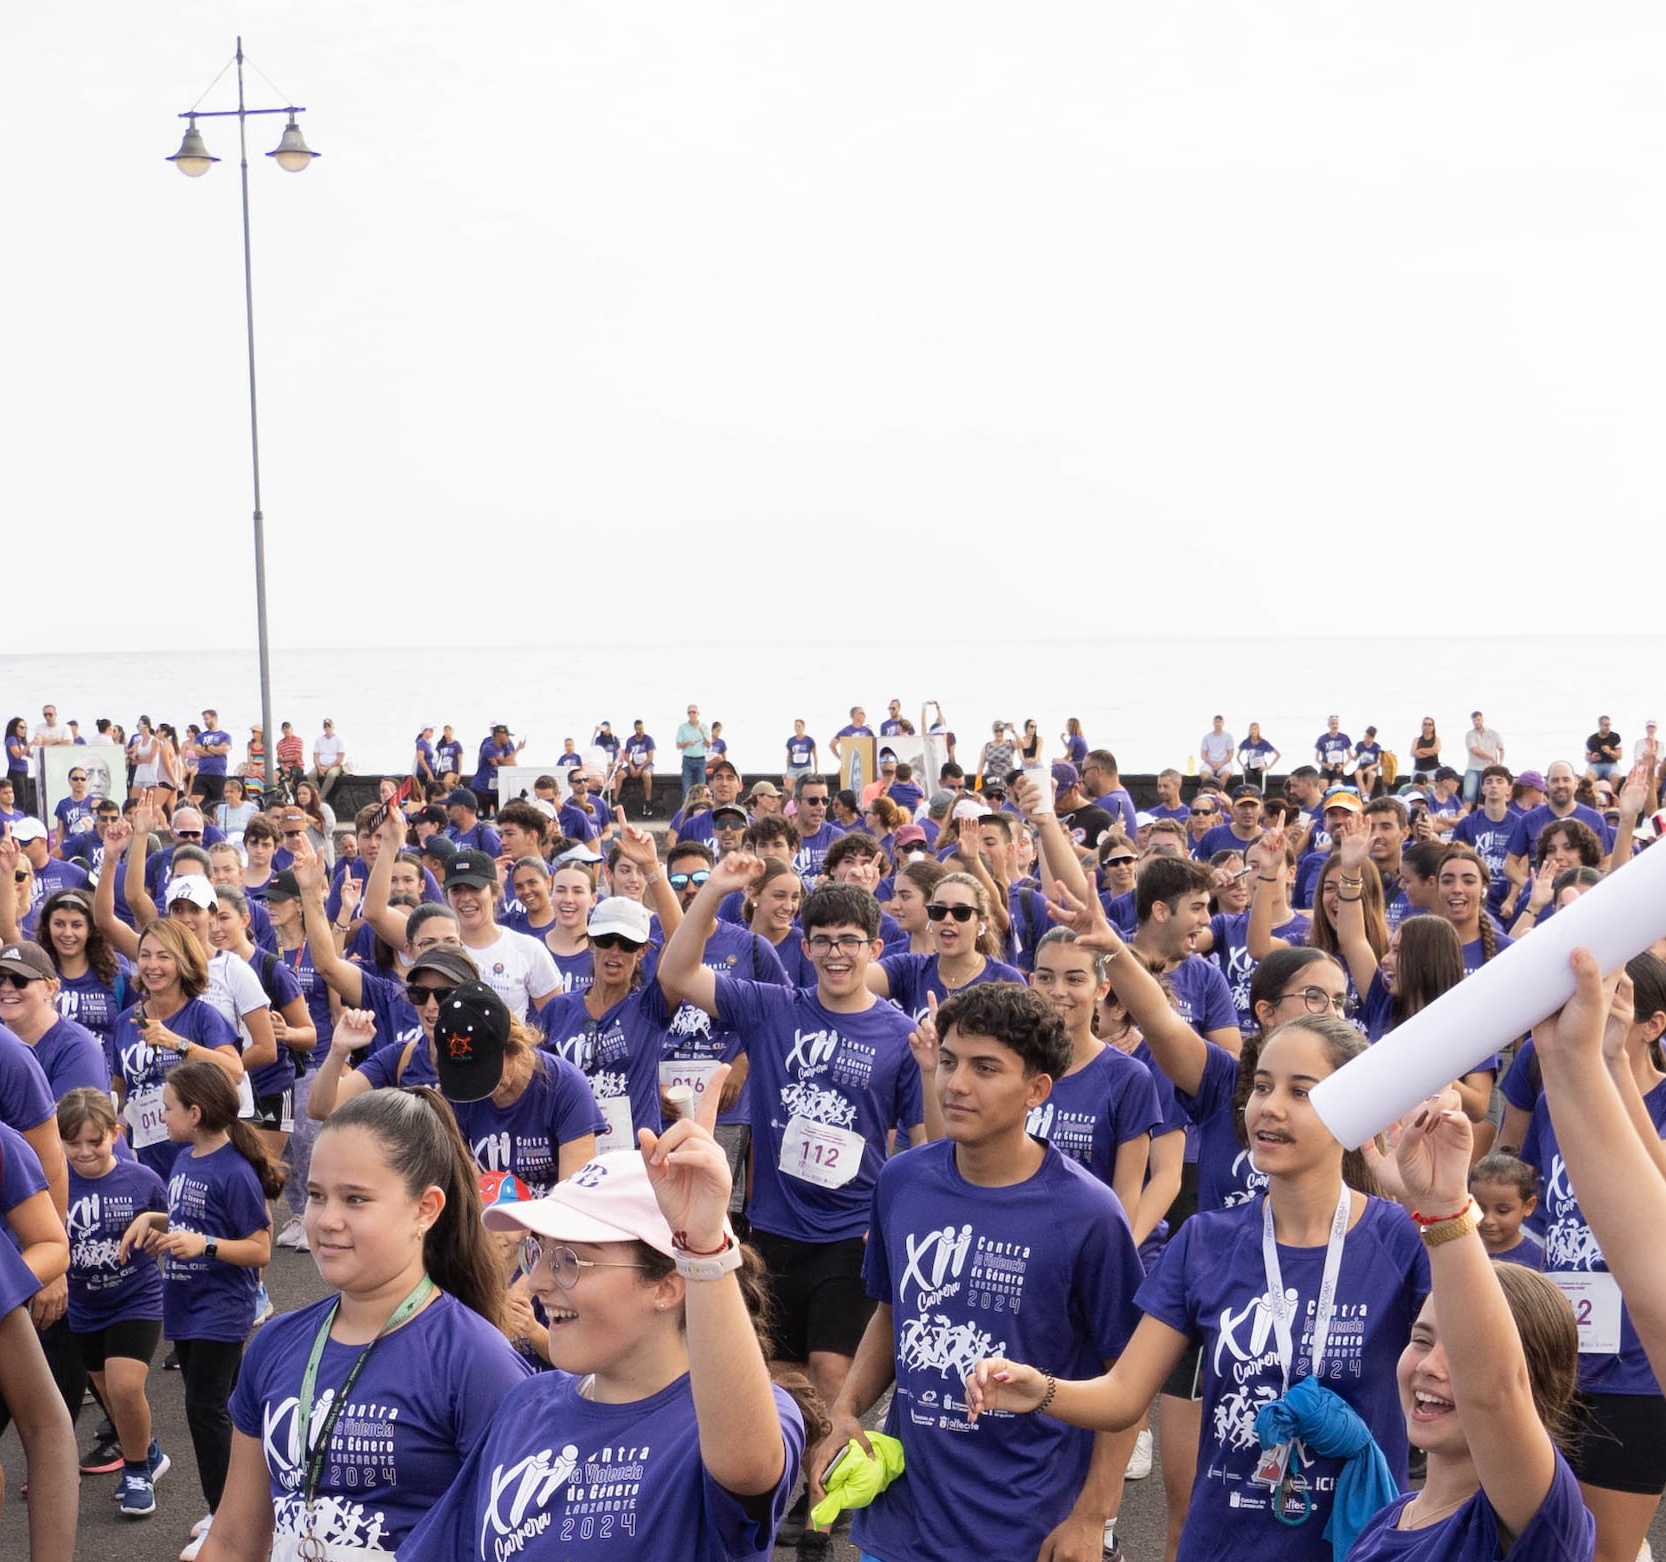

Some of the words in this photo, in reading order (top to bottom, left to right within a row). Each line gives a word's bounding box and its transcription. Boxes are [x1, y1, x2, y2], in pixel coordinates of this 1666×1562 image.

[841, 1037, 876, 1056] Contra
[847, 1056, 872, 1071] Género
[832, 1071, 870, 1090] 2024
[1057, 1109, 1096, 1124] Contra
[516, 1136, 549, 1147] Contra
[1064, 1131, 1093, 1143] Género
[801, 1140, 840, 1168] 112
[977, 1236, 1031, 1258] Contra
[971, 1266, 982, 1278] de
[986, 1268, 1023, 1285] Género
[970, 1279, 1022, 1296] LANZAROTE
[917, 1282, 961, 1313] Carrera
[967, 1290, 1020, 1315] 2024
[331, 1436, 343, 1450] de
[348, 1436, 394, 1452] Género
[331, 1453, 394, 1465] LANZAROTE
[330, 1466, 397, 1486] 2024
[585, 1462, 644, 1484] Violencia
[567, 1486, 584, 1501] de
[590, 1484, 640, 1500] Género
[565, 1499, 636, 1515] LANZAROTE
[560, 1513, 636, 1541] 2024
